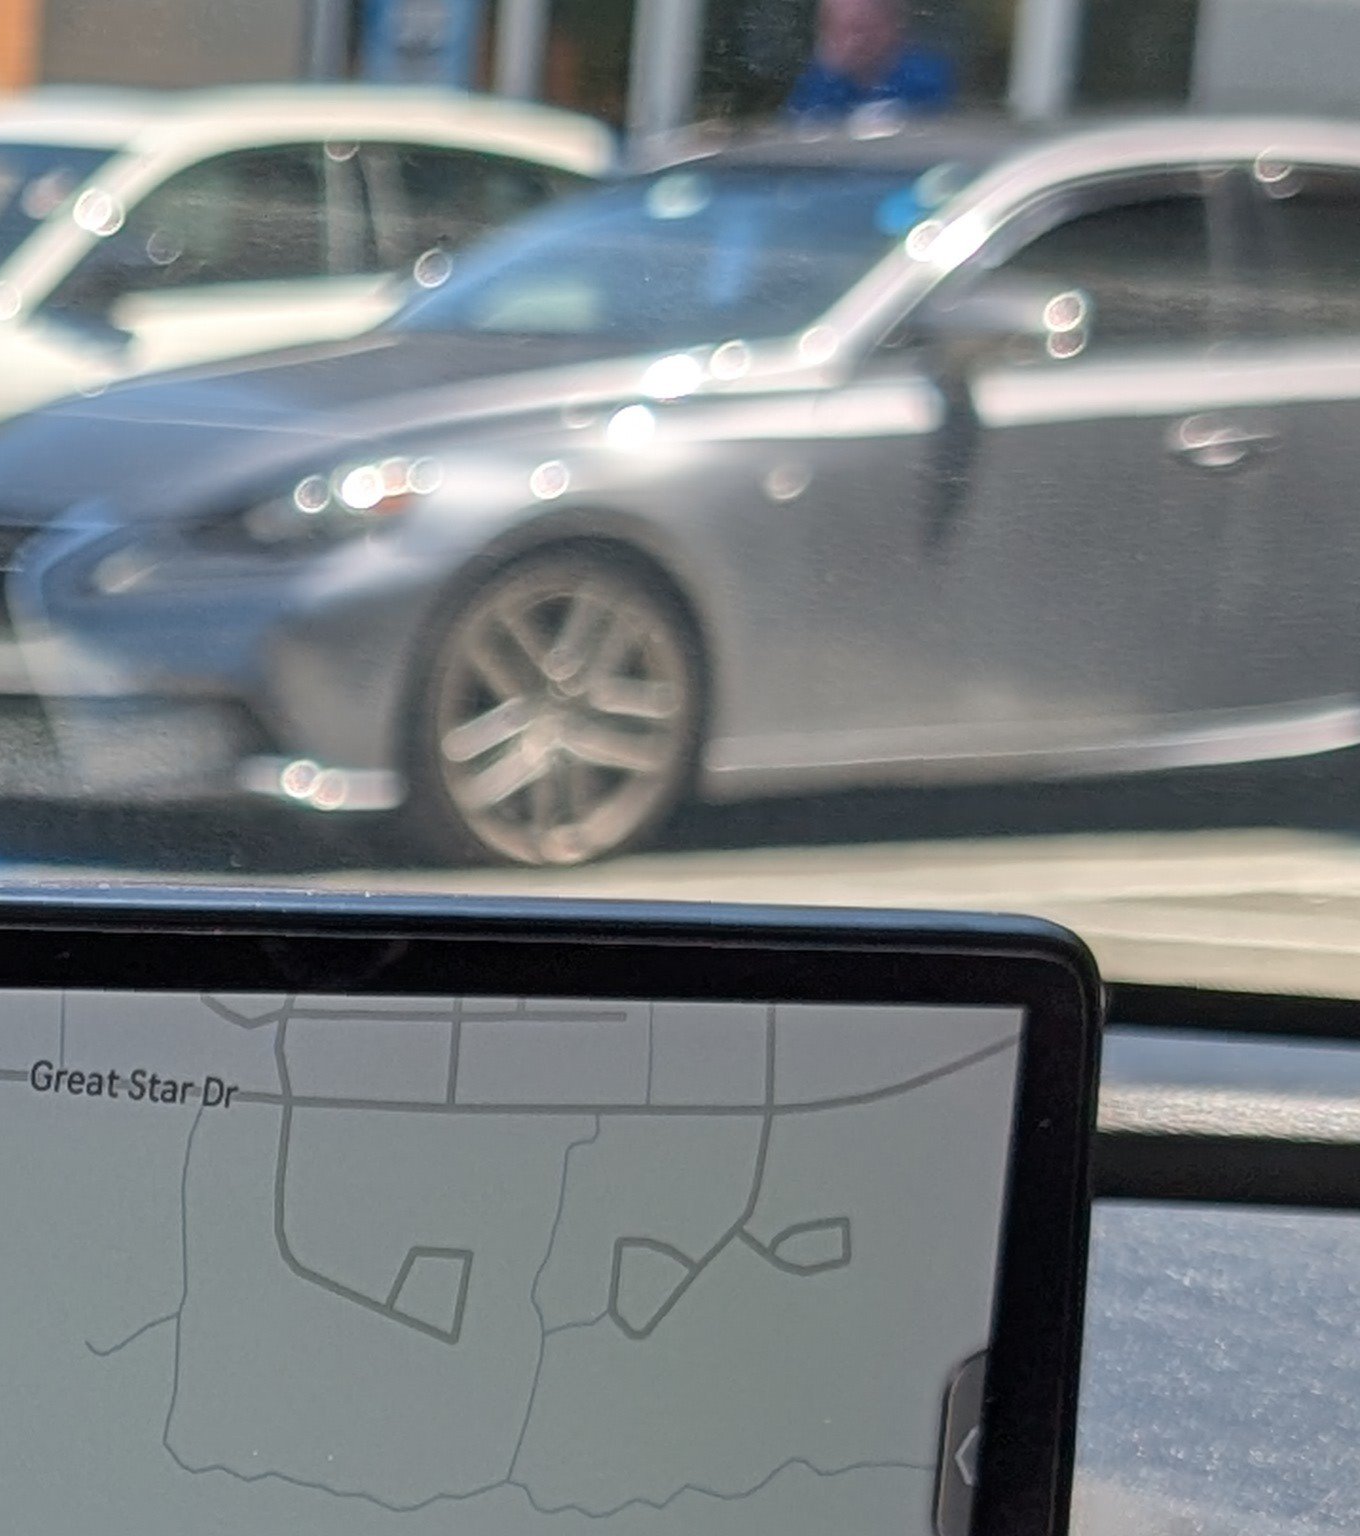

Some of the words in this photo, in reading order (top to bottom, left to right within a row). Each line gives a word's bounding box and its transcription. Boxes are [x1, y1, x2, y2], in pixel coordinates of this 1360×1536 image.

[30, 1059, 121, 1099] Great
[127, 1069, 195, 1104] Star
[201, 1076, 239, 1109] Dr
